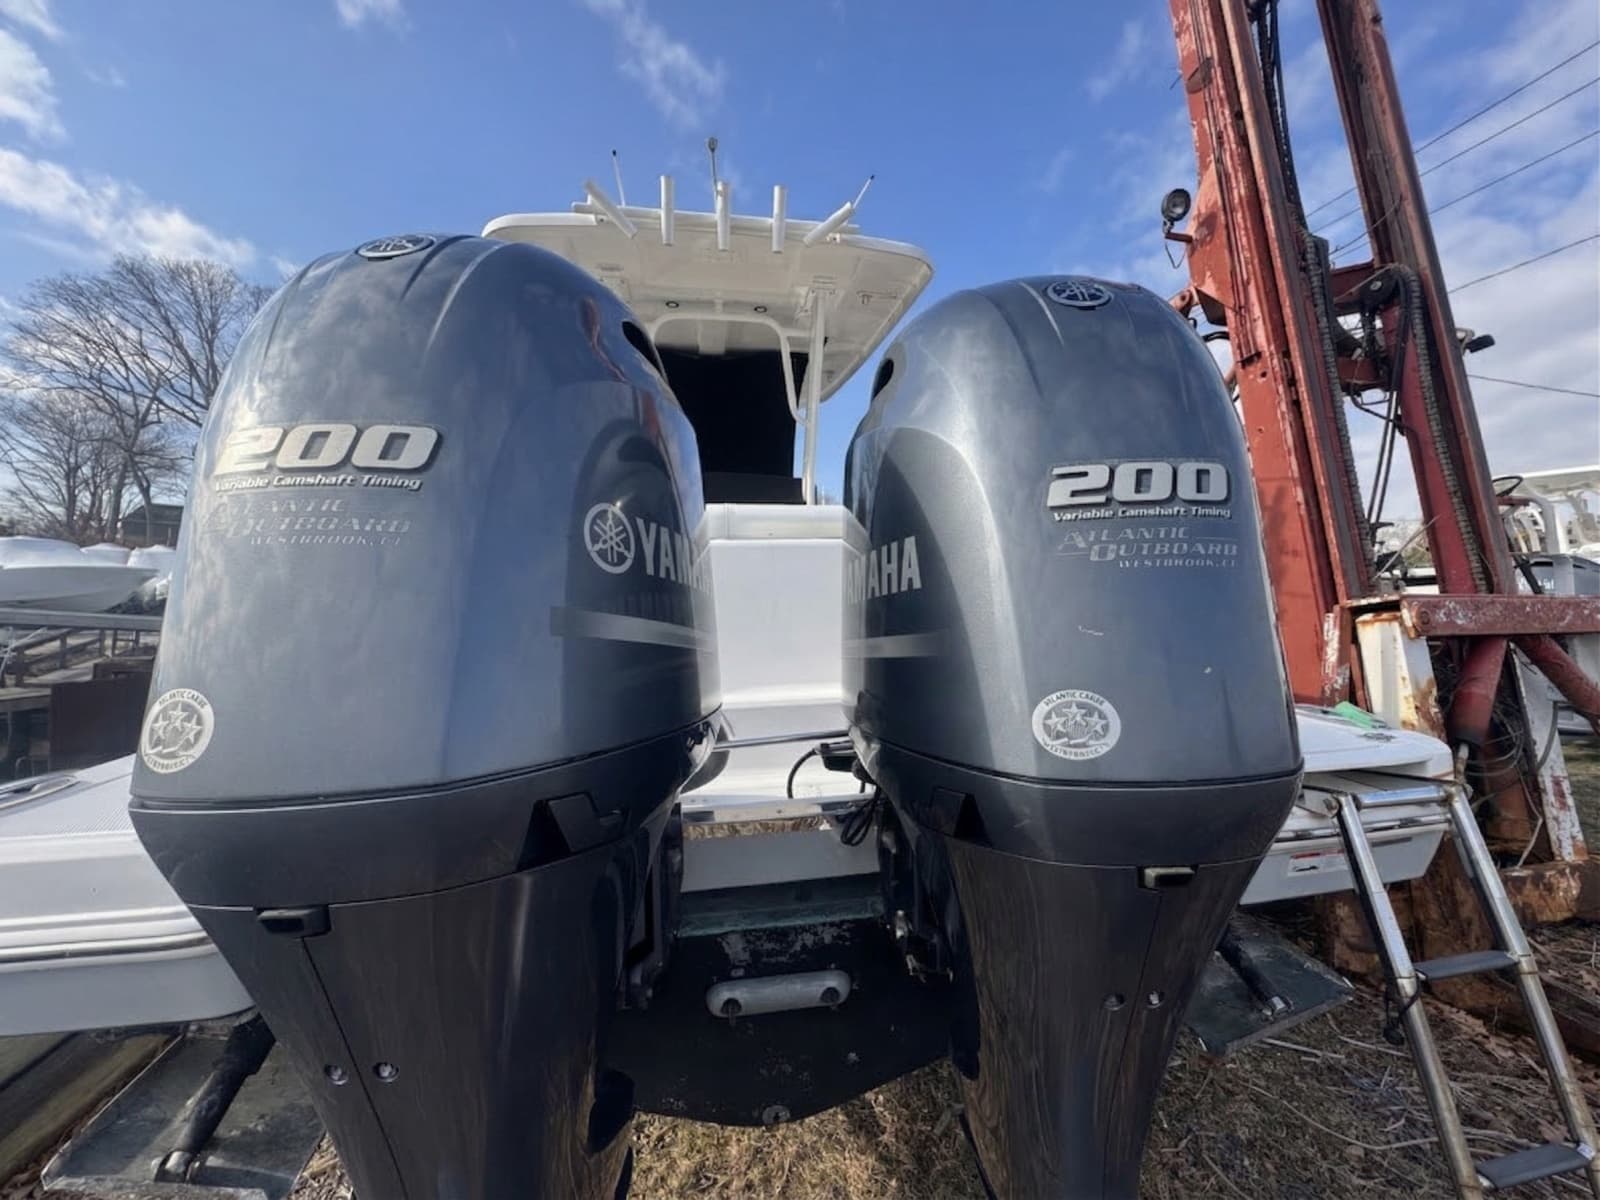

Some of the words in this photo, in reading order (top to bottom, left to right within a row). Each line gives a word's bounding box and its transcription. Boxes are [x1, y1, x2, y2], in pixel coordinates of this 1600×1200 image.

[213, 423, 440, 476] 200
[214, 476, 269, 491] Variable
[272, 474, 355, 488] Camshaft
[361, 474, 422, 491] Timing
[1047, 461, 1229, 507] 200
[1053, 508, 1113, 522] Variable
[1118, 506, 1187, 518] Camshaft
[1191, 506, 1232, 519] Timing
[1058, 526, 1190, 550] ATLANTIC
[1089, 542, 1238, 562] OUTBOARD
